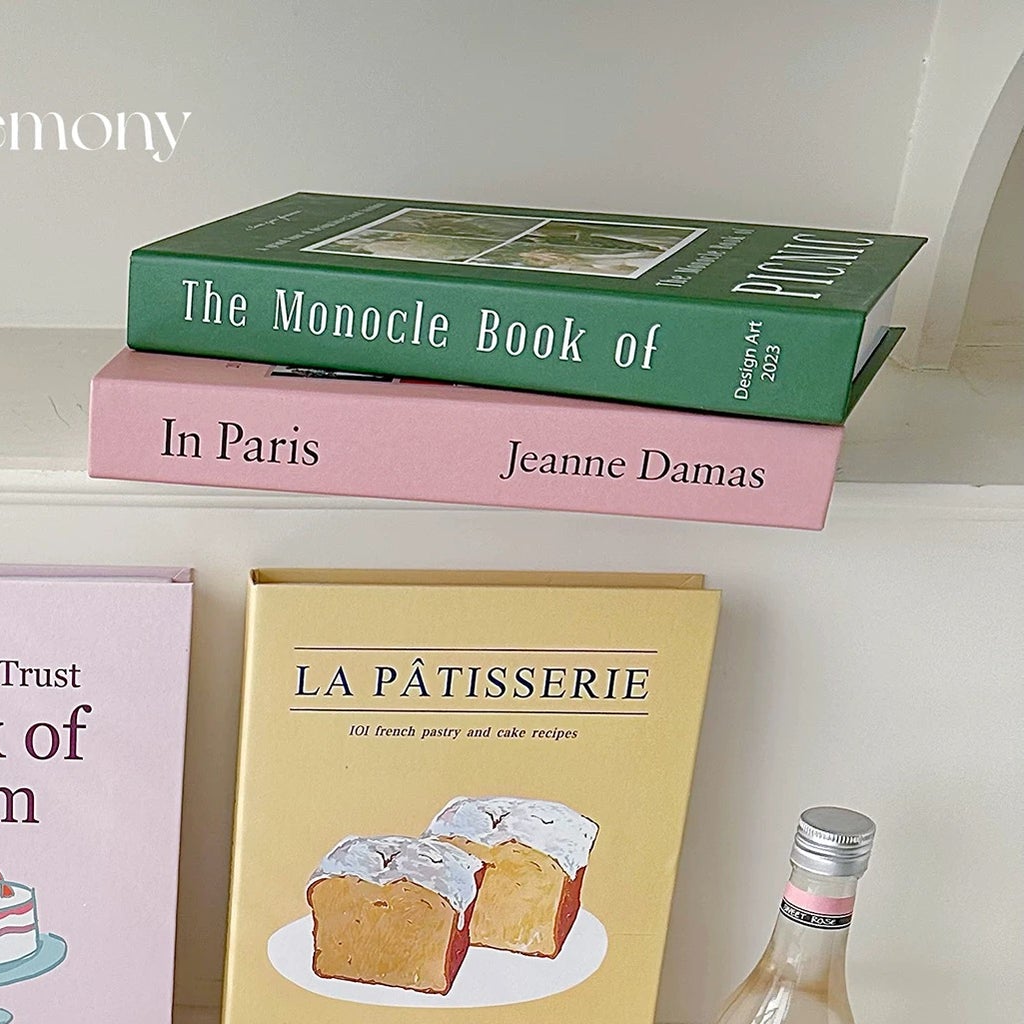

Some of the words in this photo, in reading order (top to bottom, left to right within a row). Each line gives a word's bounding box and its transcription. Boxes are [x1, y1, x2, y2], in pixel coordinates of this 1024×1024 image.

[731, 233, 875, 299] PICNIC
[182, 279, 248, 328] The
[272, 288, 450, 348] Monocle
[476, 308, 587, 362] Book
[614, 323, 662, 370] of
[745, 320, 764, 345] Art
[734, 348, 758, 400] Design
[761, 345, 781, 382] 2023
[161, 417, 202, 459] In
[216, 421, 320, 466] Paris
[500, 439, 627, 482] Jeanne
[636, 449, 768, 491] Damas
[294, 664, 354, 697] LA
[372, 657, 650, 700] PÂTISSERIE
[25, 703, 93, 760] of
[375, 725, 416, 738] french
[421, 726, 462, 740] pastry
[467, 726, 490, 739] and
[497, 726, 526, 739] cake
[531, 727, 578, 741] recipes
